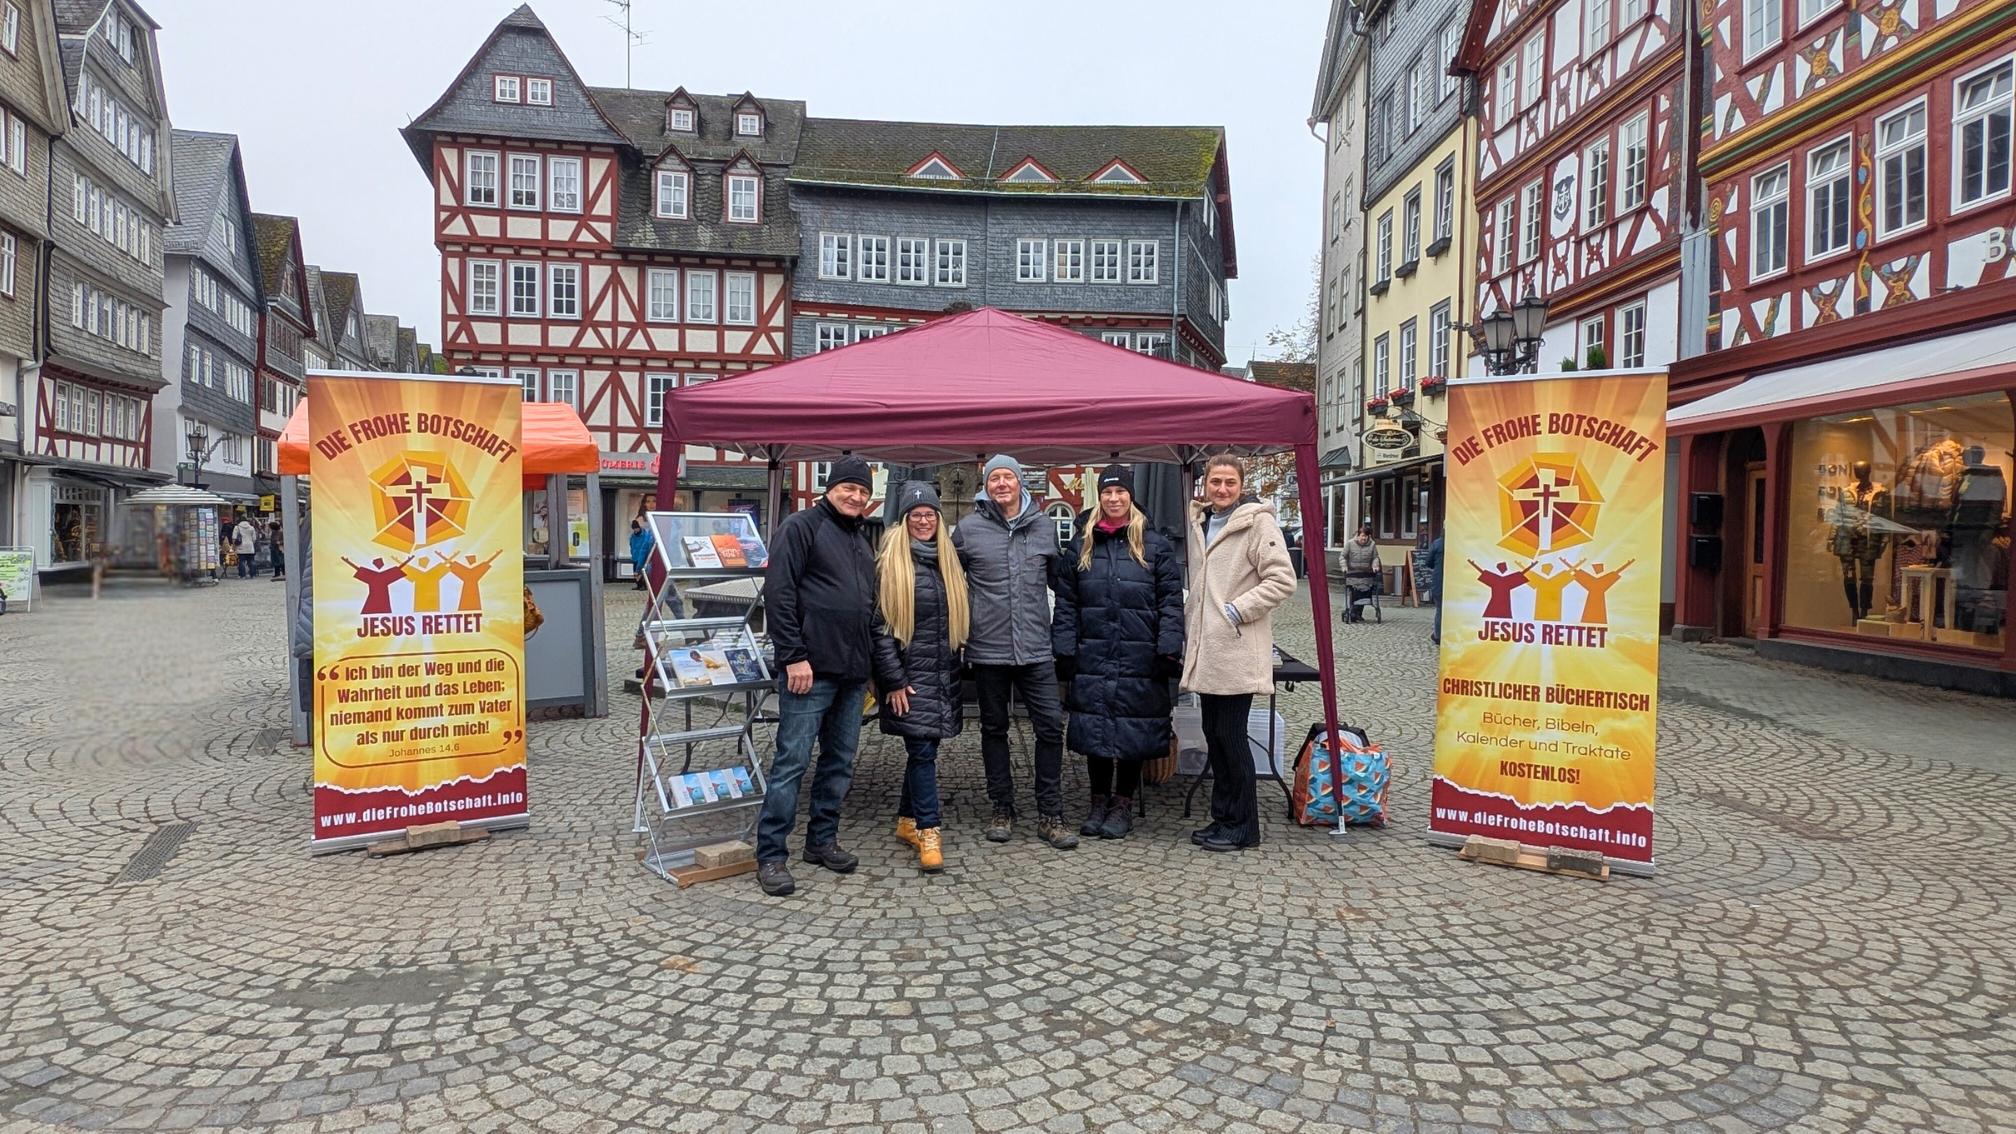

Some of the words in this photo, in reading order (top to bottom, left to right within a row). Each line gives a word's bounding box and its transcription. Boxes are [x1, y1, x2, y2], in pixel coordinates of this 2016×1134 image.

[1984, 225, 2016, 263] B
[316, 429, 353, 461] DIE
[348, 413, 411, 444] FROHE
[417, 413, 518, 463] BOTSCHAFT
[1452, 435, 1485, 466] DIE
[1482, 414, 1541, 449] FROHE
[1548, 413, 1659, 462] BOTSCHAFT
[357, 615, 415, 638] JESUS
[422, 613, 483, 635] RETTET
[1478, 621, 1535, 643] JESUS
[1542, 624, 1608, 648] RETTET
[346, 666, 367, 681] Ich
[372, 664, 393, 680] bin
[399, 663, 420, 678] der
[425, 661, 452, 680] Weg
[458, 659, 481, 674] und
[486, 658, 504, 672] die
[338, 685, 401, 703] Wahrheit
[406, 684, 430, 698] und
[435, 682, 458, 697] das
[1443, 678, 1540, 702] CHRISTLICHER
[1546, 684, 1650, 712] BÜCHERTISCH
[330, 708, 392, 726] niemand
[396, 704, 444, 722] kommt
[448, 703, 475, 717] zum
[479, 699, 512, 714] Vater
[1483, 712, 1540, 730] Bücher,
[1546, 718, 1599, 736] Bibeln,
[357, 731, 378, 746] als
[383, 730, 405, 743] nur
[409, 724, 449, 741] durch
[453, 721, 490, 737] mich!
[1457, 731, 1524, 750] Kalender
[1529, 740, 1558, 753] und
[1563, 741, 1631, 761] Traktate
[389, 745, 436, 758] Johannes
[1500, 761, 1581, 784] KOSTENLOS!
[321, 791, 523, 827] www.dieFroheBotschaft.info
[1436, 807, 1647, 848] www.dieFroheBotschaft.info
